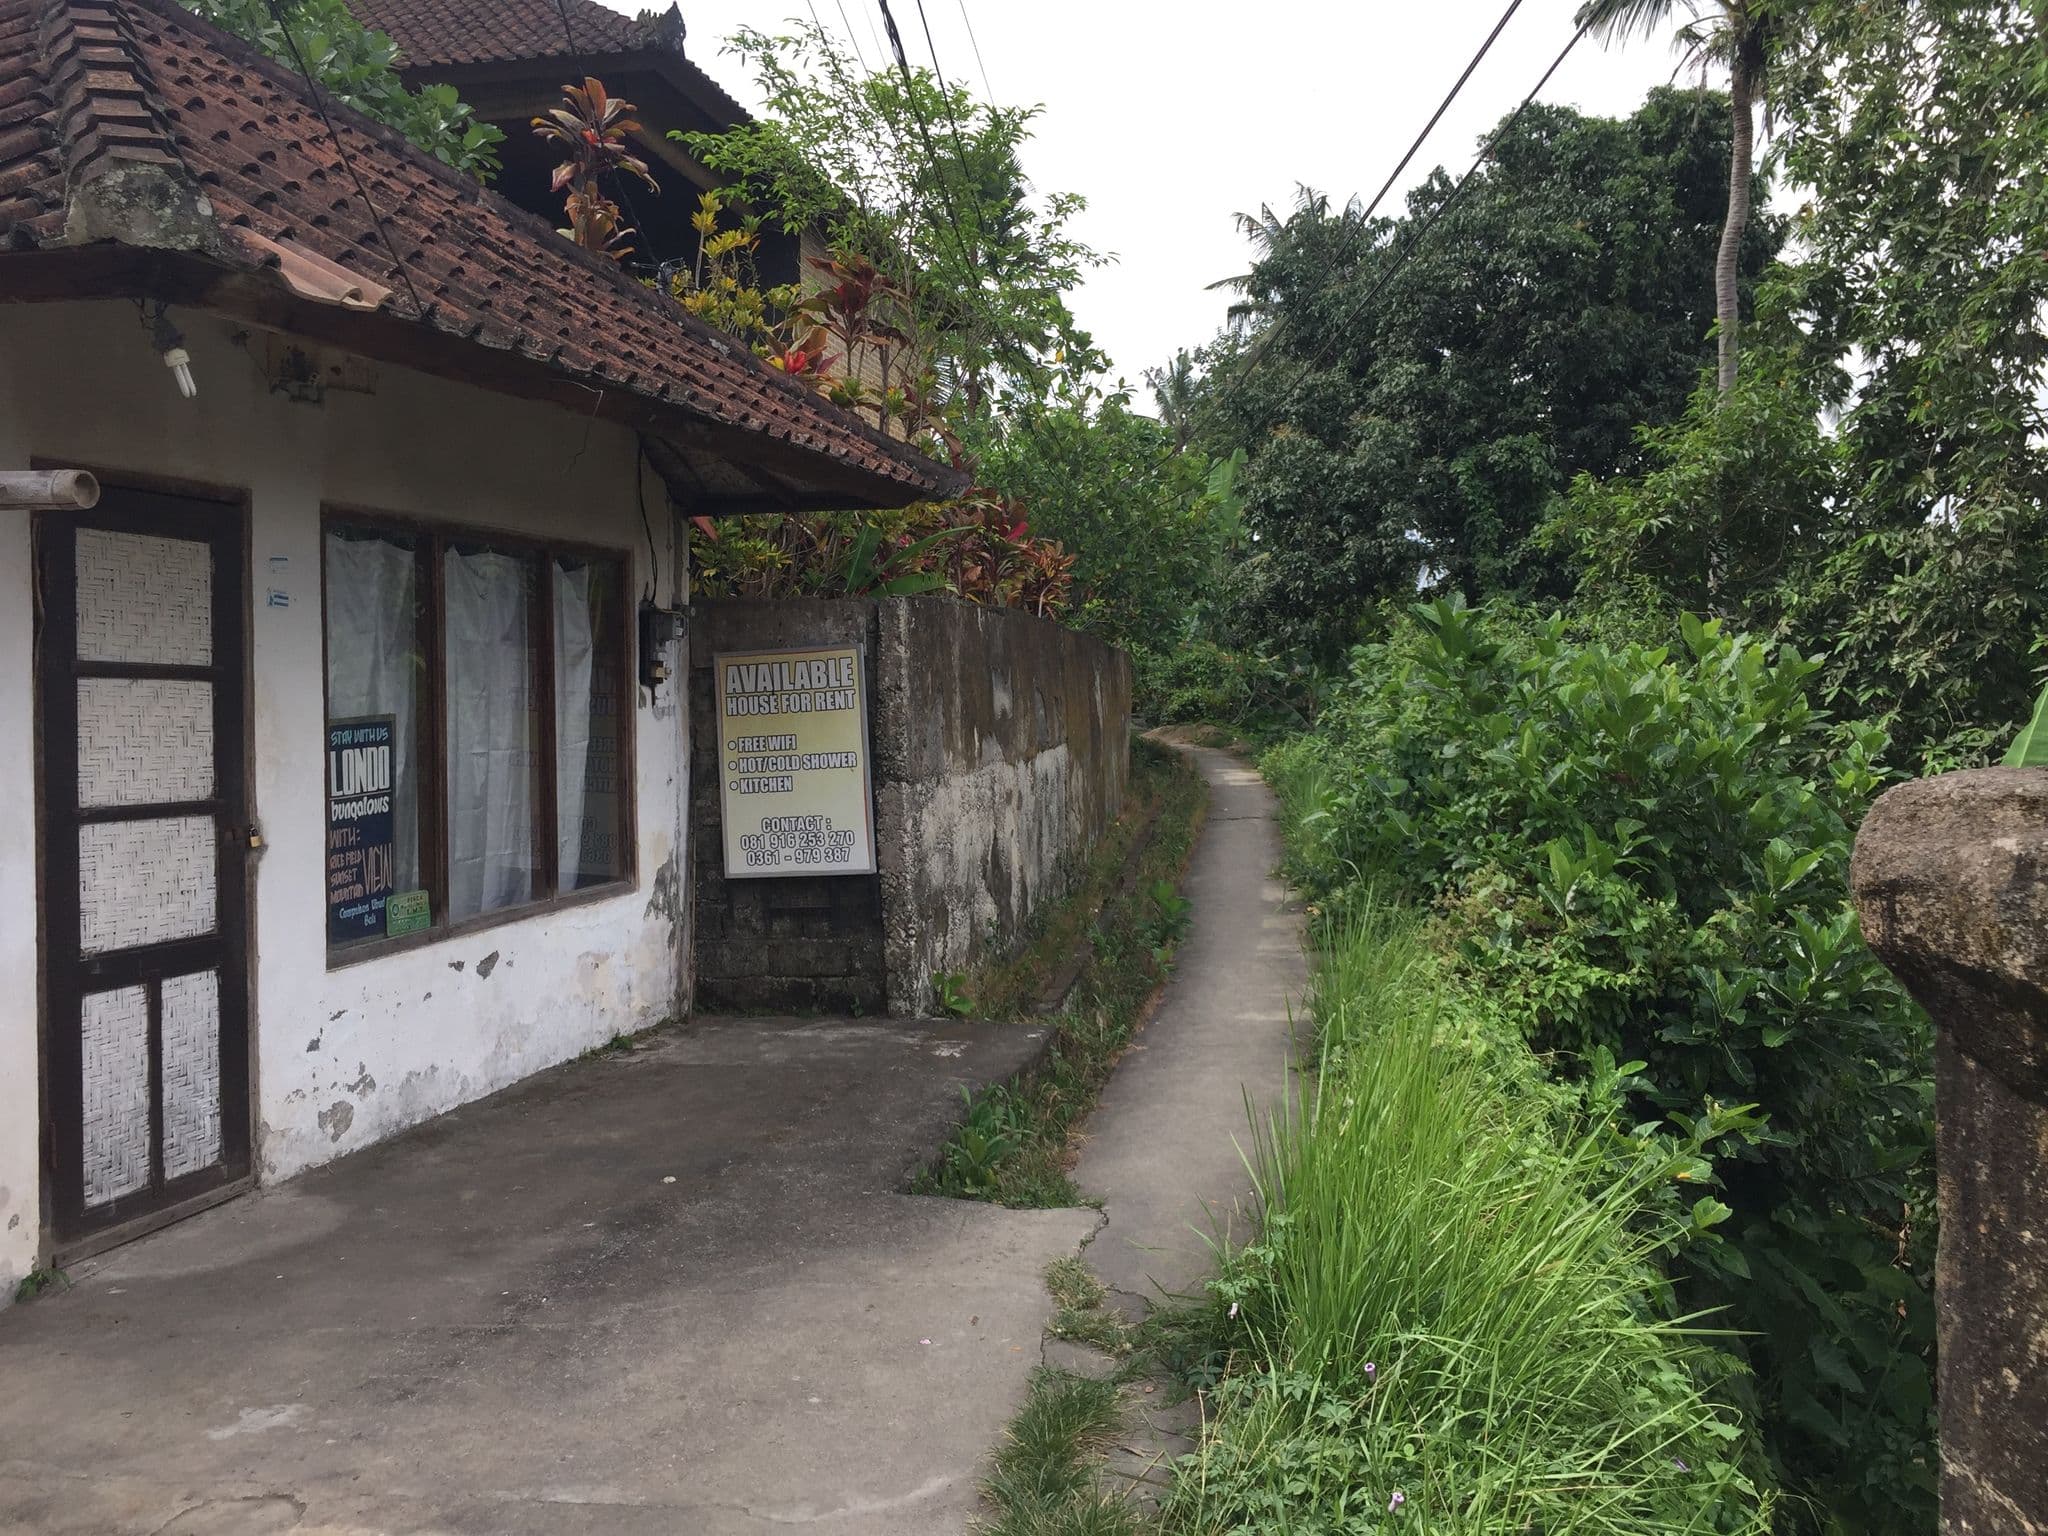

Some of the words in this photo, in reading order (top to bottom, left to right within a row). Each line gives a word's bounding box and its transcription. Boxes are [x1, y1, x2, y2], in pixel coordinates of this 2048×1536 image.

[726, 657, 855, 694] AVAILABLE
[726, 694, 779, 716] HOUSE
[780, 692, 813, 713] FOR
[815, 690, 856, 711] RENT
[330, 729, 352, 747] STAY
[354, 728, 375, 743] WITH
[376, 727, 389, 742] US
[737, 736, 766, 752] FREE
[767, 734, 797, 751] WIFI
[330, 746, 390, 797] LONDO
[739, 755, 801, 773] HOT/COLD
[802, 752, 857, 770] SHOWER
[740, 776, 793, 794] KITCHEN
[331, 796, 389, 822] bungalows
[761, 816, 823, 833] CONTACT
[330, 826, 361, 849] WITH:
[740, 835, 765, 851] 081
[770, 833, 796, 849] 916
[800, 832, 825, 848] 253
[829, 831, 855, 846] 270
[747, 851, 780, 866] 0361
[795, 848, 822, 864] 979
[824, 847, 850, 862] 387
